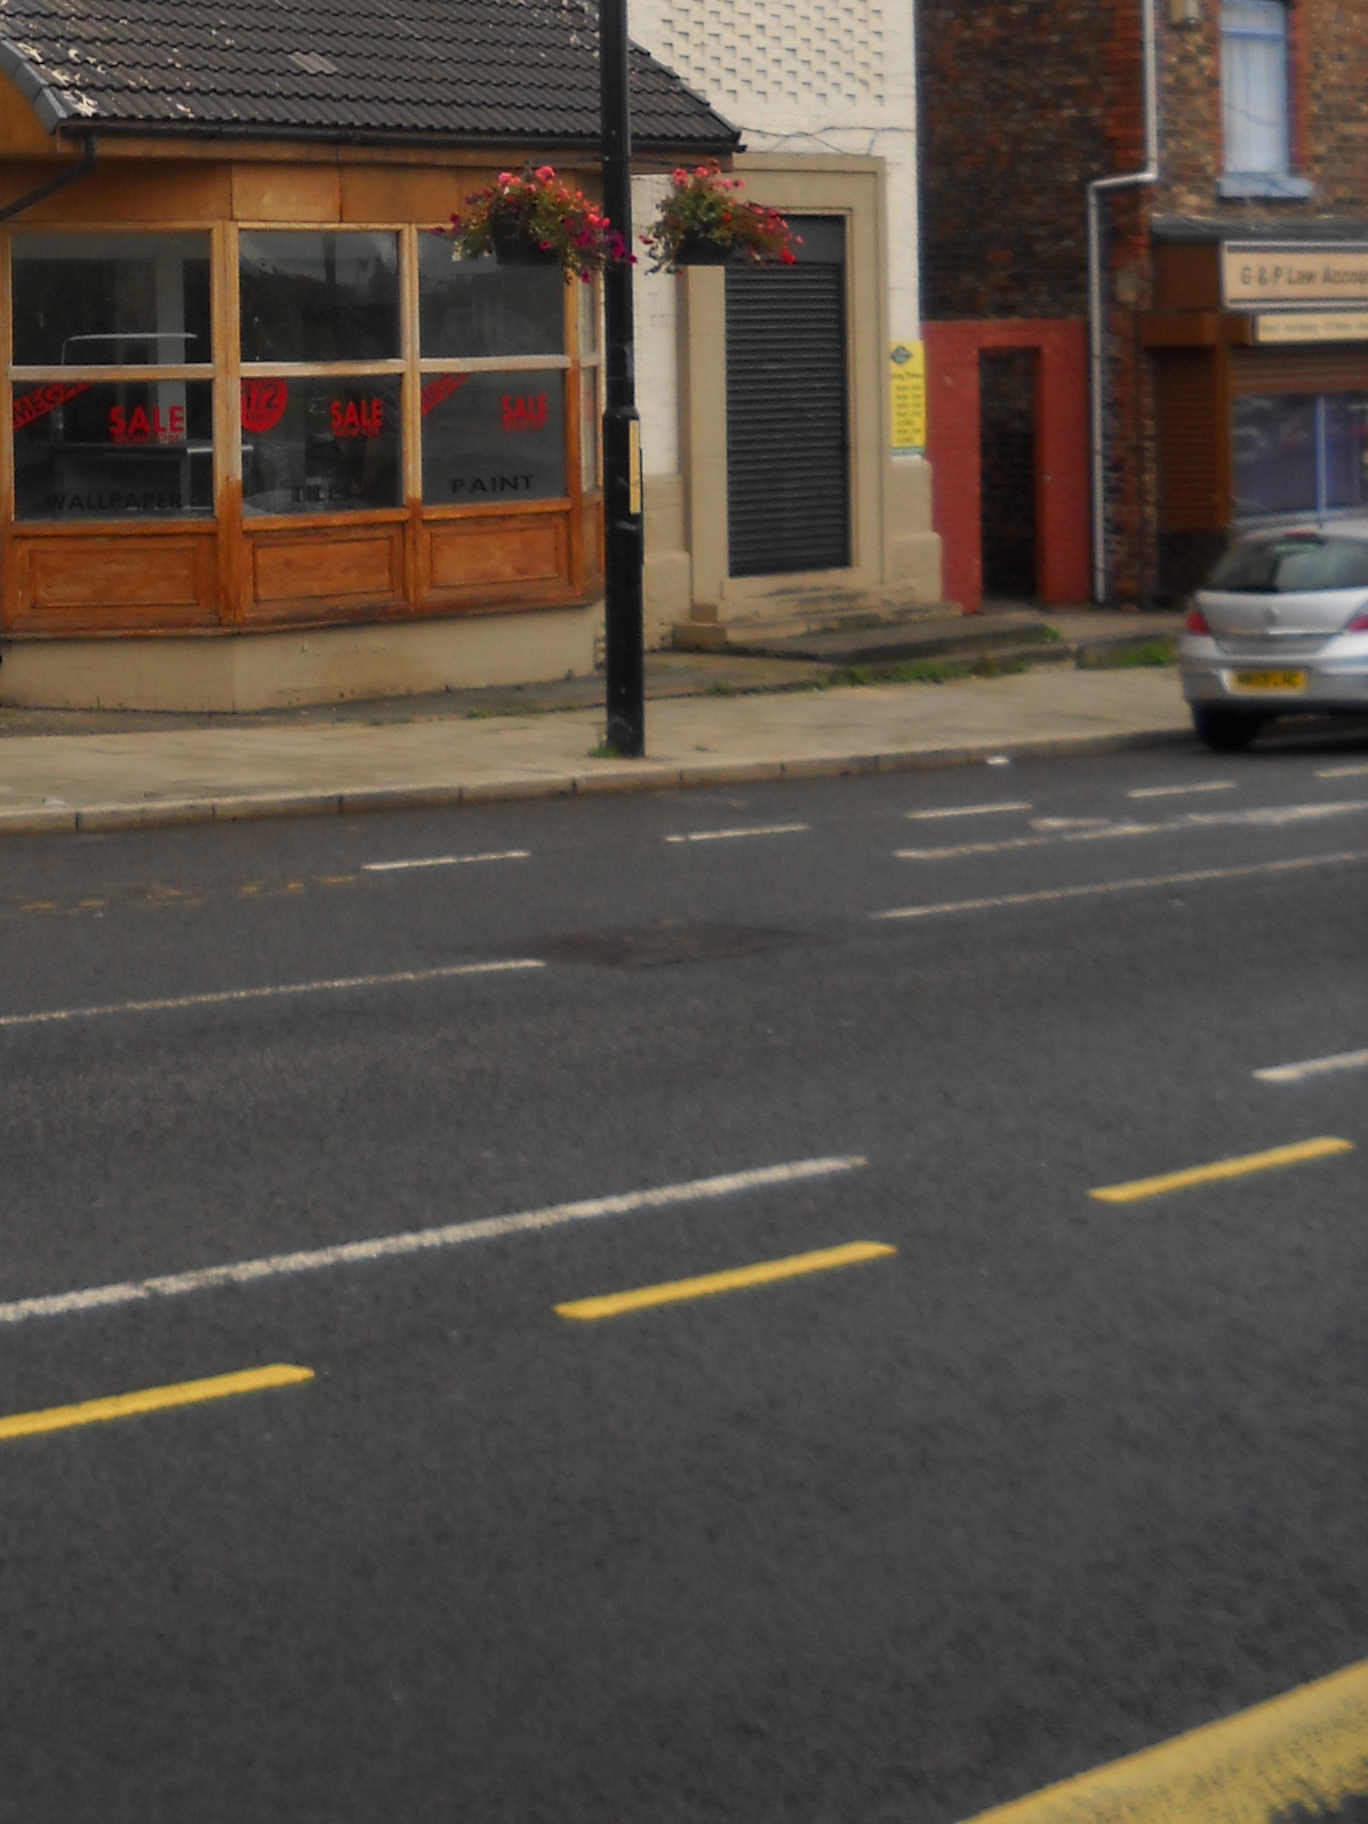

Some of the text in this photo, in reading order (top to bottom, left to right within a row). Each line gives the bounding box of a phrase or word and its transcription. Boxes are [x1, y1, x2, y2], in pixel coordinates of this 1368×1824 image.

[109, 405, 184, 434] SALE
[330, 398, 384, 427] SALE
[501, 393, 548, 420] SALE
[451, 474, 534, 494] PAINT
[48, 491, 183, 510] WALLPAPER
